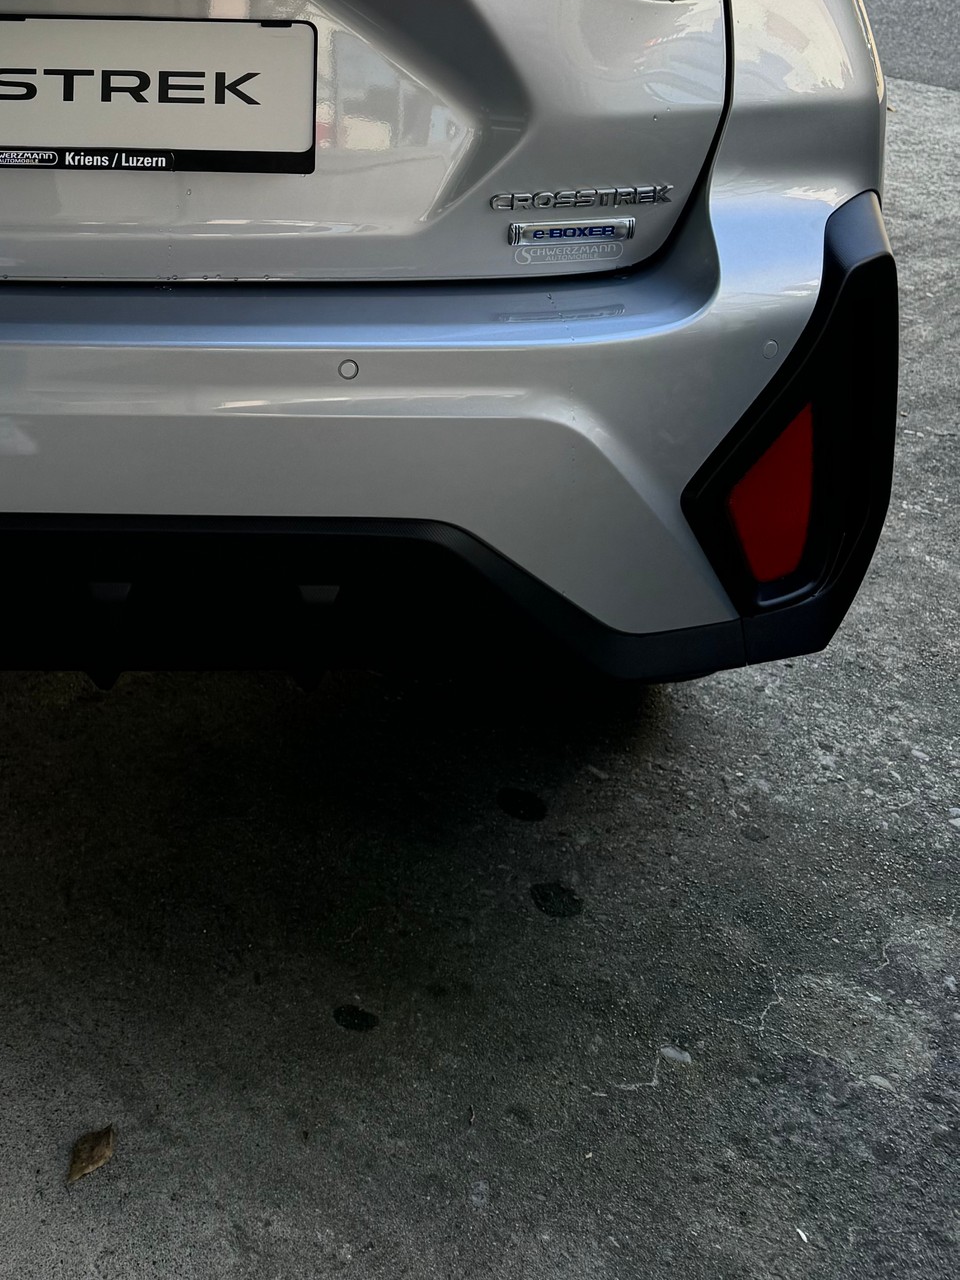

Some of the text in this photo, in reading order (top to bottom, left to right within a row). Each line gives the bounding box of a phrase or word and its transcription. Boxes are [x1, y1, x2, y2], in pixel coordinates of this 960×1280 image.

[65, 152, 167, 168] Kriens / Luzern
[490, 184, 674, 211] CROSSTREK
[533, 225, 616, 239] e-BOXER
[545, 253, 599, 261] AUTOMOBILE
